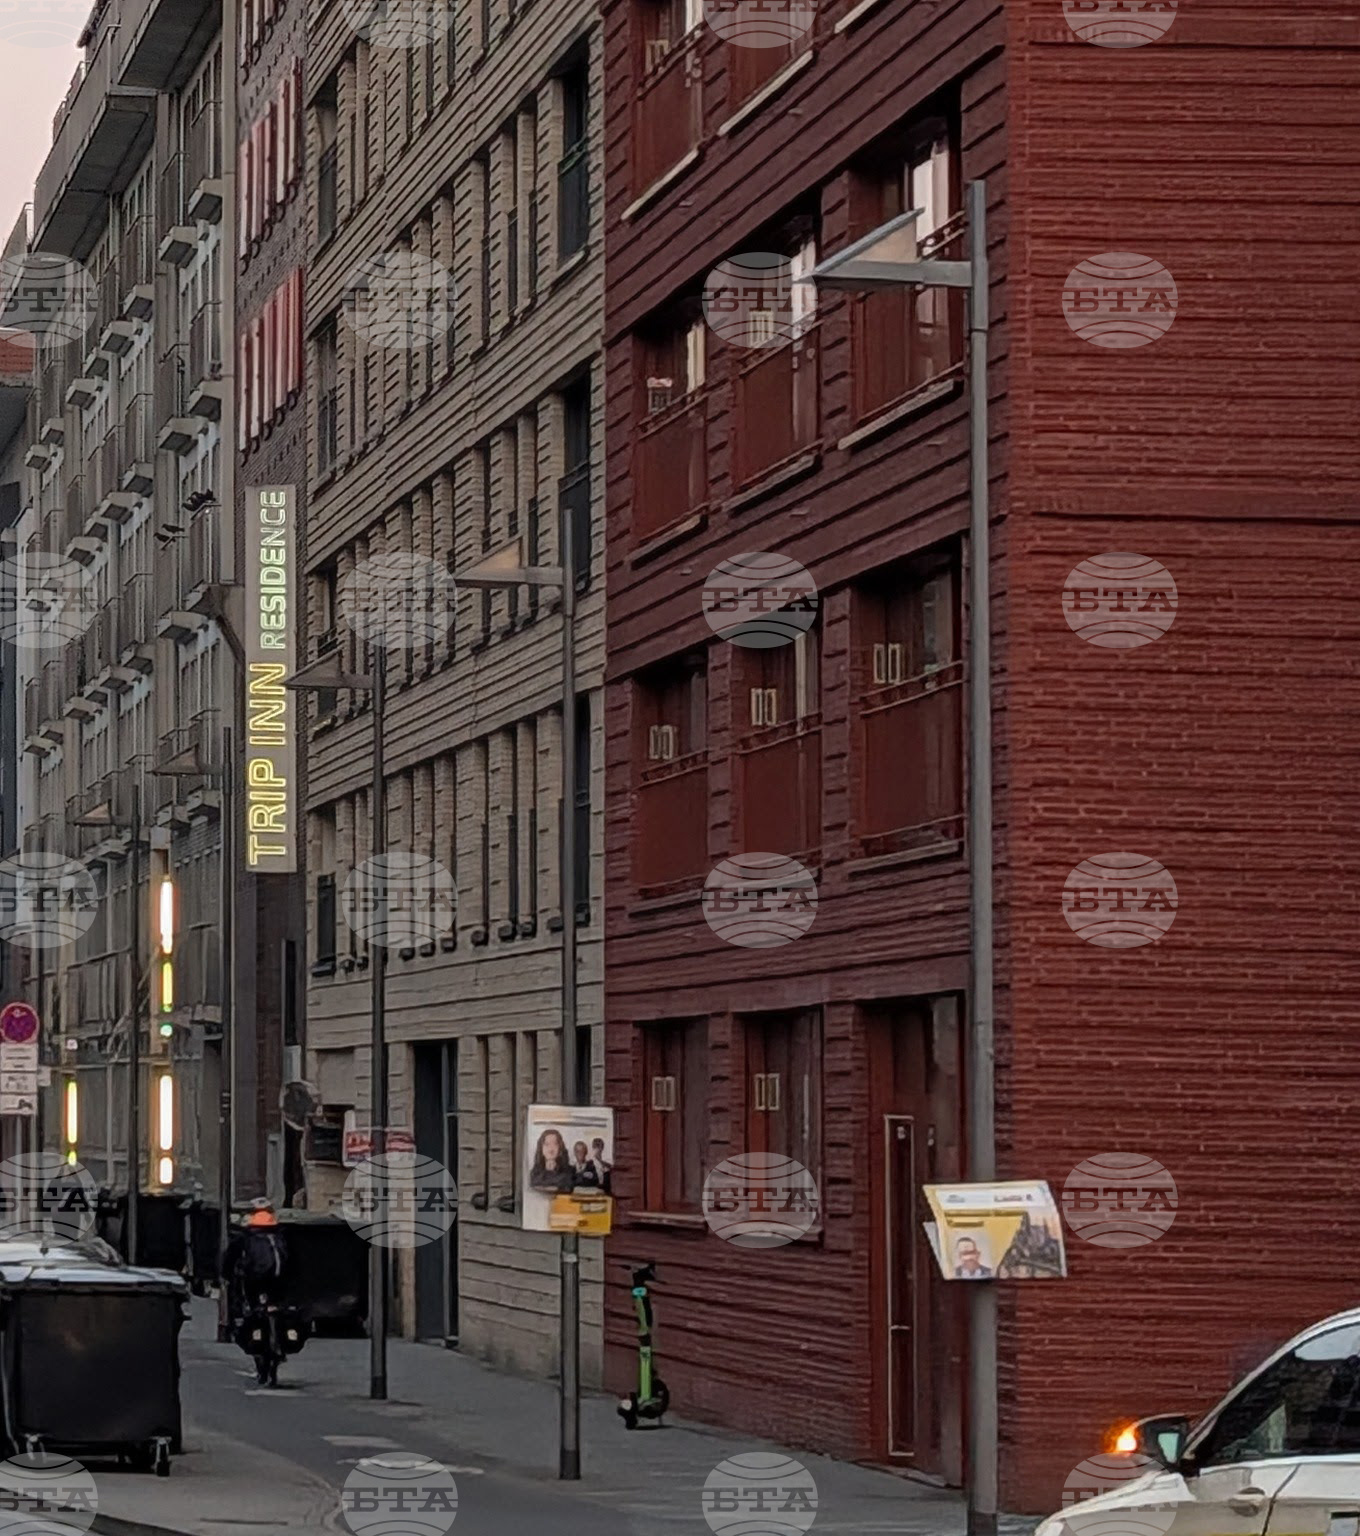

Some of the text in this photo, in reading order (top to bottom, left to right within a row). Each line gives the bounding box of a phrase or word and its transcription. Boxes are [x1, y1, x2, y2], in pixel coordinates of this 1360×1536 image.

[249, 491, 286, 864] TRIP INN RESIDENCE
